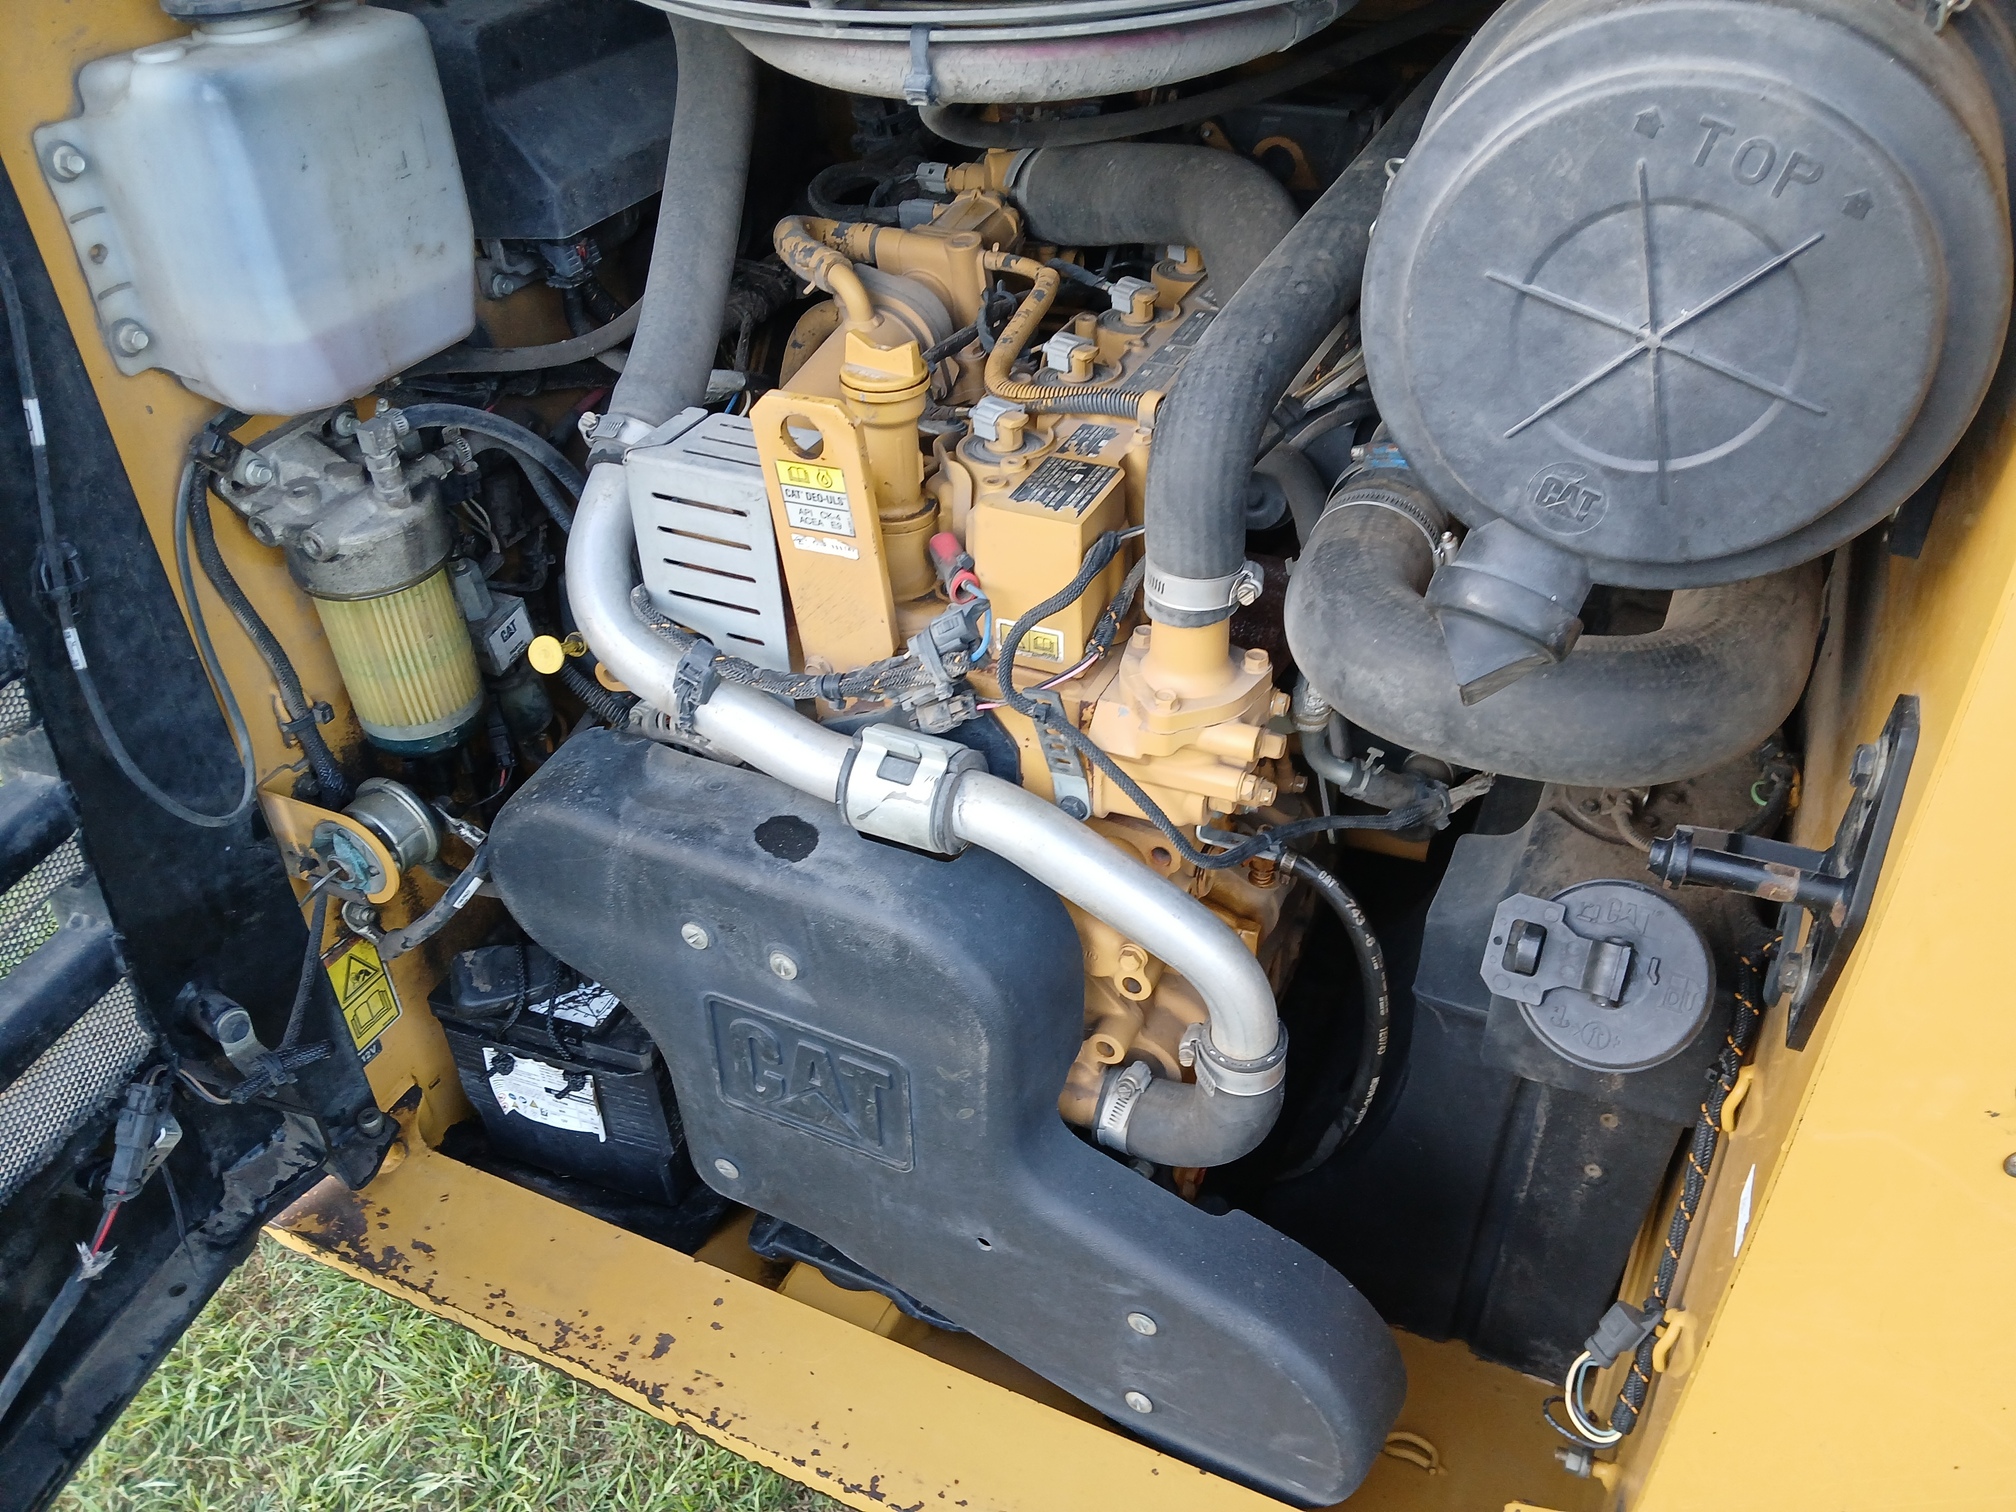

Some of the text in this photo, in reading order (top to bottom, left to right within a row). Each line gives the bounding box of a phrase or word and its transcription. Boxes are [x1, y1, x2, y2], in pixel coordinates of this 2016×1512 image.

[1692, 113, 1825, 199] TOP
[1534, 474, 1604, 523] CAT
[500, 618, 517, 643] CAT
[1345, 898, 1366, 926] 743
[360, 1043, 378, 1063] 12V
[728, 1017, 893, 1150] CAT
